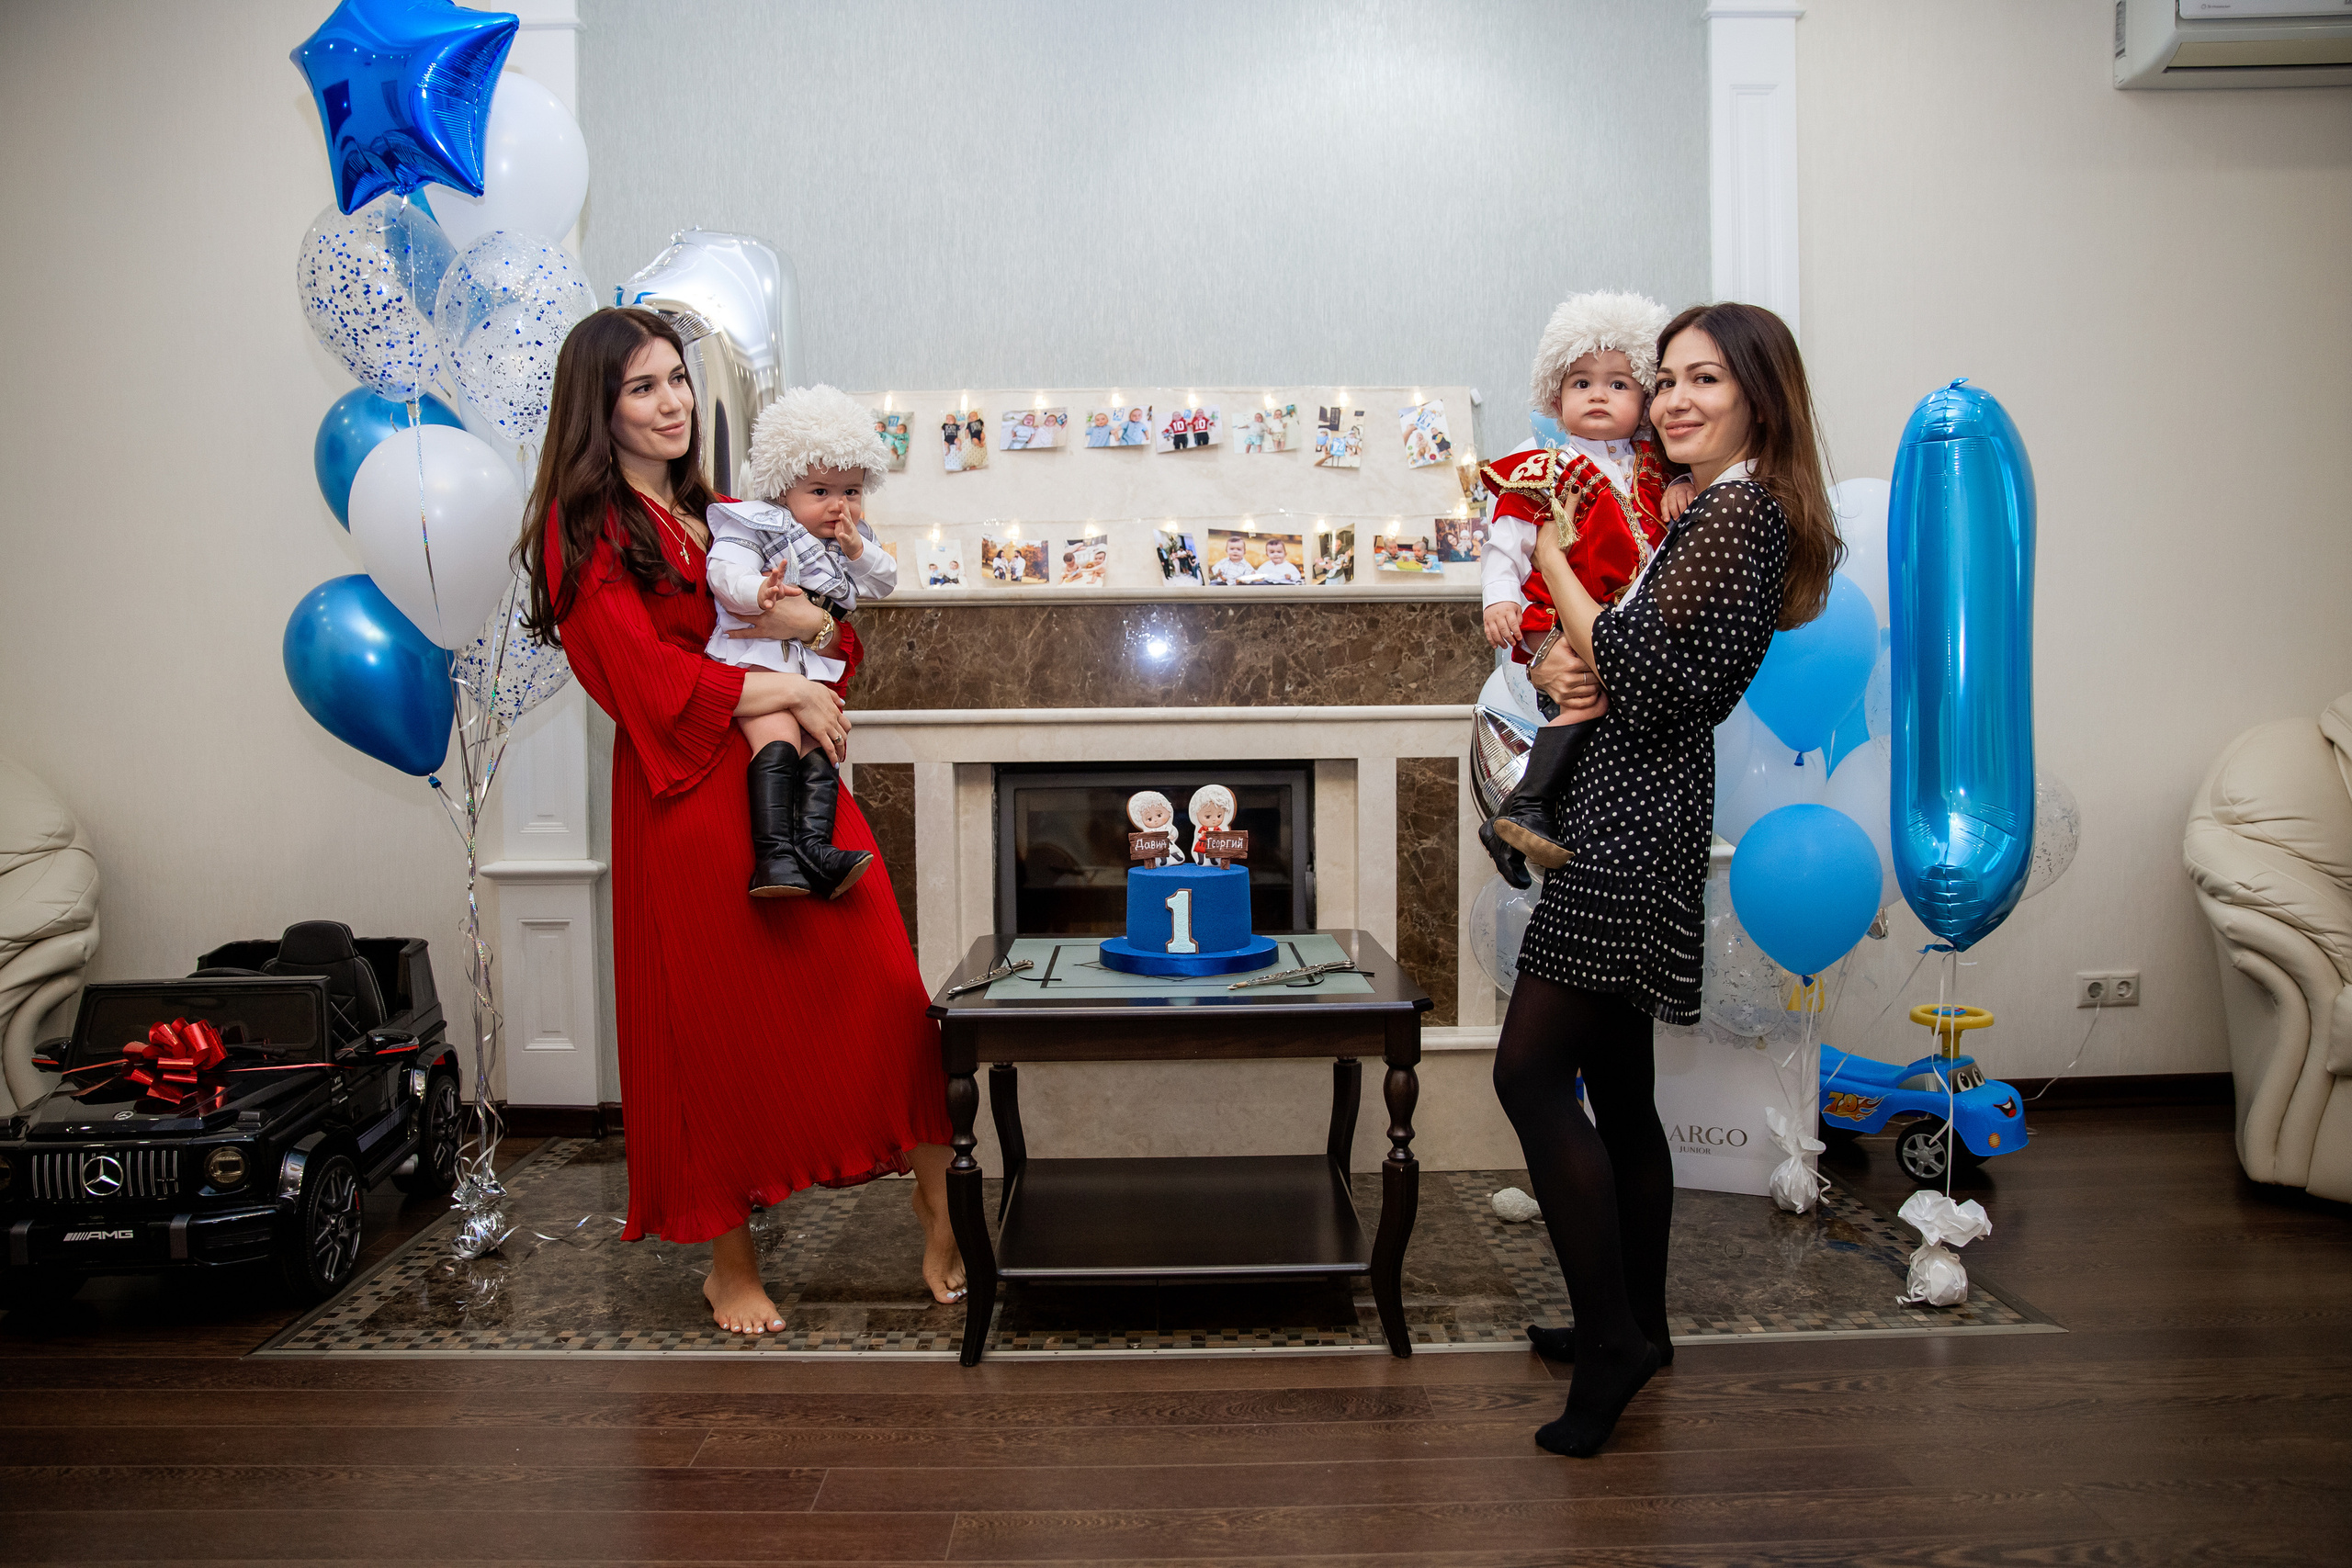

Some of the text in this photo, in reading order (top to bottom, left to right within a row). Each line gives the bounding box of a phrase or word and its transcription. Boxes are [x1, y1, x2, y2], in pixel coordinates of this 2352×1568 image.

[1173, 421, 1185, 432] 10
[1206, 837, 1244, 851] Георгий
[1165, 888, 1199, 954] 1
[1663, 1123, 1747, 1147] ARGO
[1679, 1145, 1711, 1155] JUNIOR
[85, 1230, 133, 1241] AMG
